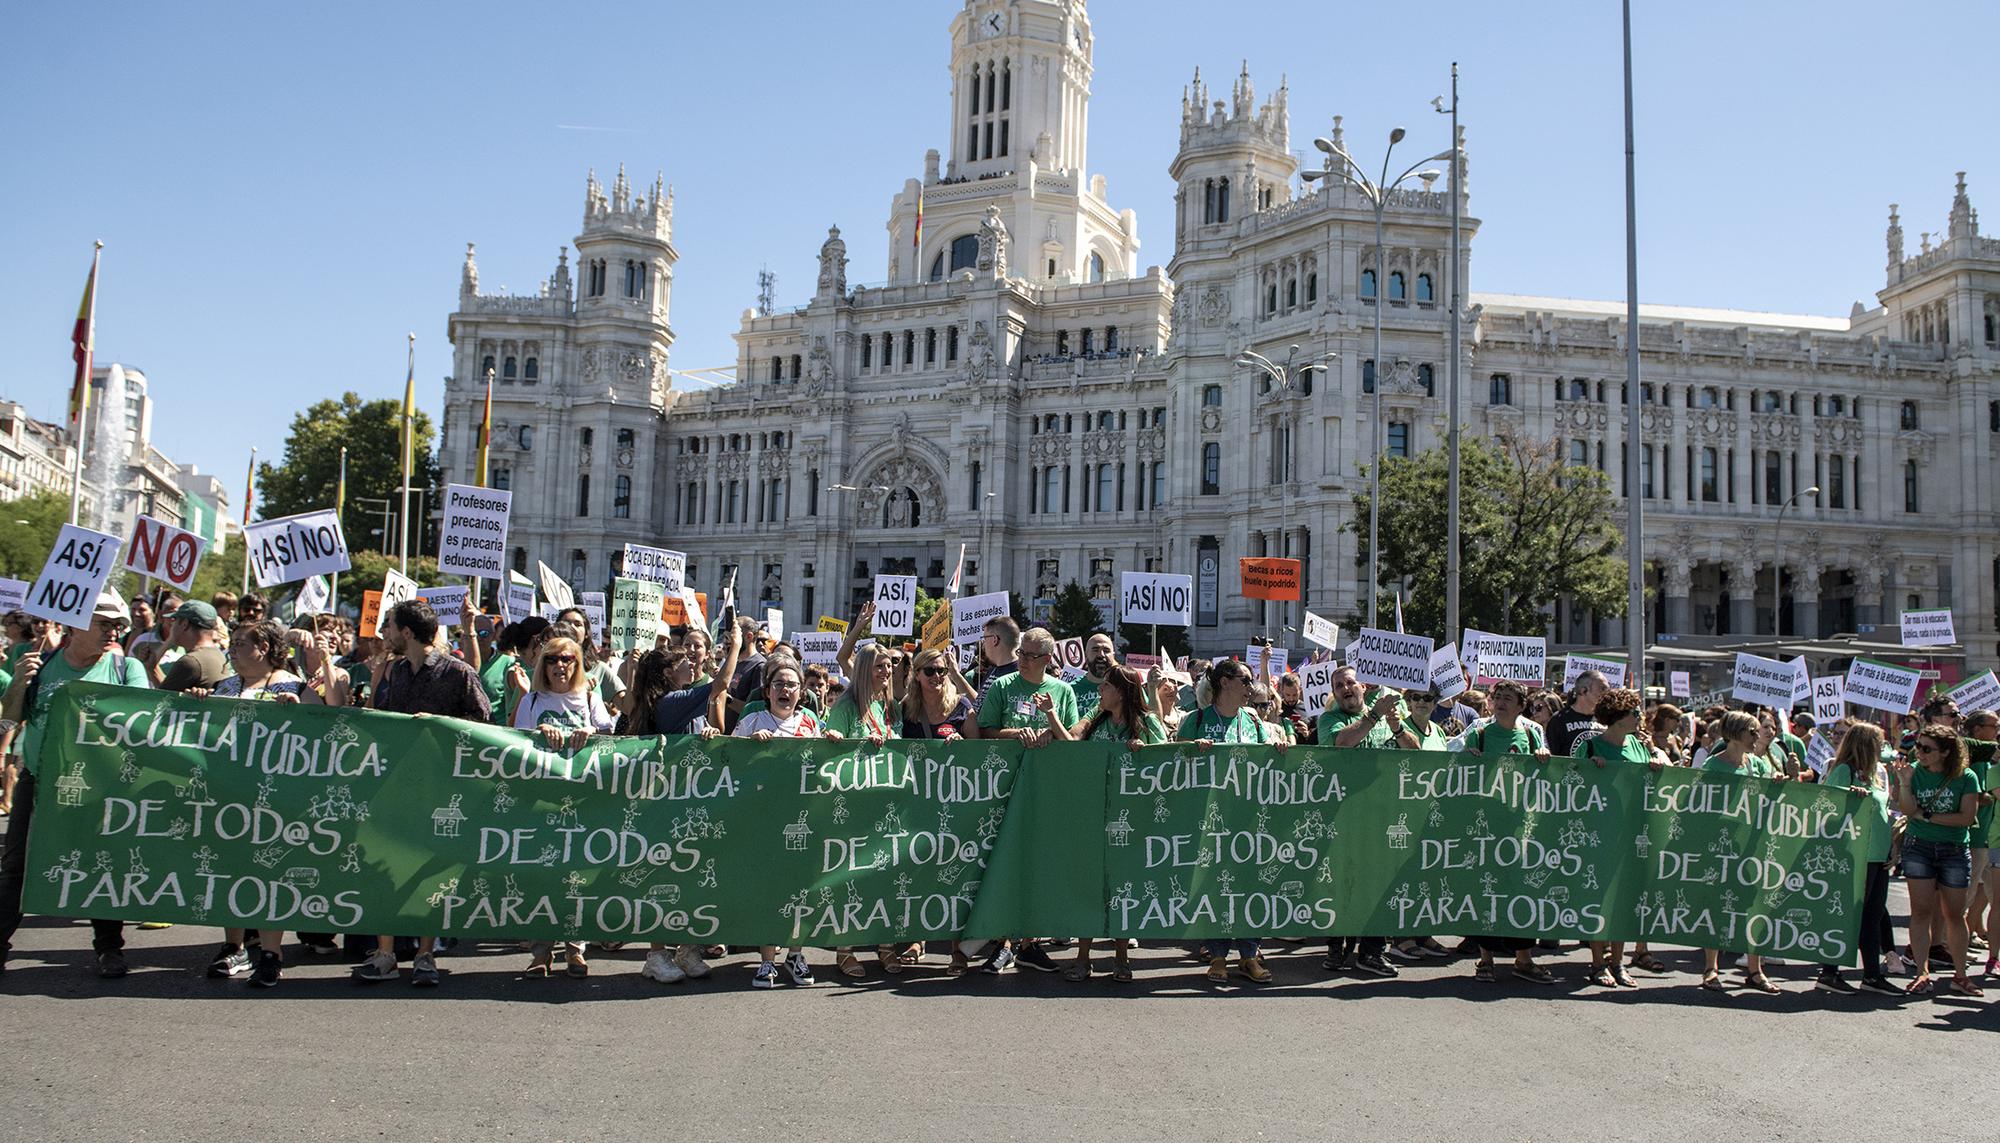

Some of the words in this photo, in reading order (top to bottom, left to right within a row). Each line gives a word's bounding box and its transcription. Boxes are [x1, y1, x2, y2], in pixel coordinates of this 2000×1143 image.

[451, 492, 508, 513] Profesores
[451, 514, 503, 533] precarios,
[55, 538, 106, 579] ASÍ,
[126, 518, 197, 584] NO
[254, 525, 299, 579] ¡ASÍ
[300, 523, 344, 561] NO!
[446, 535, 459, 547] es
[461, 536, 504, 552] precaria
[444, 553, 502, 572] educación.
[1248, 565, 1269, 576] Becas
[1275, 566, 1294, 576] ricos
[38, 579, 90, 615] NO!
[615, 587, 623, 600] La
[877, 578, 910, 605] ASÍ,
[1125, 580, 1156, 616] ¡ASÍ
[1160, 587, 1190, 612] NO!
[1268, 578, 1297, 589] podrido.
[616, 609, 625, 619] un
[877, 609, 906, 628] NO!
[957, 623, 981, 637] hechas
[960, 611, 973, 622] Las
[974, 606, 1004, 620] escuelas,
[612, 626, 623, 636] no
[625, 626, 657, 641] negocio!
[1359, 634, 1381, 653] POCA
[1382, 638, 1430, 665] EDUCACIÓN,
[1480, 640, 1525, 657] PRIVATIZAN
[1526, 645, 1544, 661] para
[1305, 666, 1330, 689] ASÍ
[1357, 658, 1377, 676] POCA
[1377, 661, 1426, 685] DEMOCRACIA.
[1479, 662, 1542, 680] ENDOCTRINAR.
[1757, 668, 1773, 680] saber
[1772, 672, 1779, 681] es
[1854, 663, 1865, 676] Dar
[1864, 667, 1875, 680] más
[1875, 672, 1879, 680] a
[1880, 670, 1886, 682] la
[1885, 672, 1912, 687] educación
[1816, 679, 1840, 698] ASÍ,
[1846, 680, 1865, 697] pública,
[1865, 686, 1879, 699] nada
[1818, 703, 1840, 719] NO!
[75, 710, 237, 761] ESCUELA
[244, 720, 389, 776] PÚBLICA:
[610, 748, 740, 800] PÚBLICA:
[800, 751, 920, 796] ESCUELA
[925, 755, 1011, 803] PÚBLIC
[1119, 755, 1241, 797] ESCUELA
[1246, 758, 1347, 805] PÚBLICA:
[1398, 764, 1507, 805] ESCUELA
[1511, 768, 1607, 813] PÚBLICA:
[100, 797, 171, 837] DE
[184, 799, 341, 855] TOD@S
[1643, 783, 1751, 825] ESCUELA
[1756, 793, 1861, 840] PÚBLICA:
[477, 827, 539, 865] DE
[554, 827, 701, 873] TOD@S
[822, 835, 875, 873] DE
[1145, 834, 1199, 868] DE
[1206, 831, 1319, 870] TOD@S
[1420, 838, 1465, 870] DE
[1472, 836, 1582, 876] TOD@S
[1658, 850, 1704, 882] DE
[1715, 853, 1829, 901] TOD@S
[57, 869, 187, 908] PARA
[195, 872, 364, 927] TOD@S
[1121, 894, 1216, 931] PARA
[1220, 893, 1336, 930] TOD@S
[1398, 894, 1478, 929] PARA
[1482, 894, 1606, 935] TOD@S
[442, 895, 559, 930] PARA
[565, 895, 720, 937] TOD@S
[792, 898, 891, 939] PARA
[896, 894, 975, 932] TOD
[1639, 906, 1716, 936] PARA
[1722, 911, 1847, 959] TOD@S
